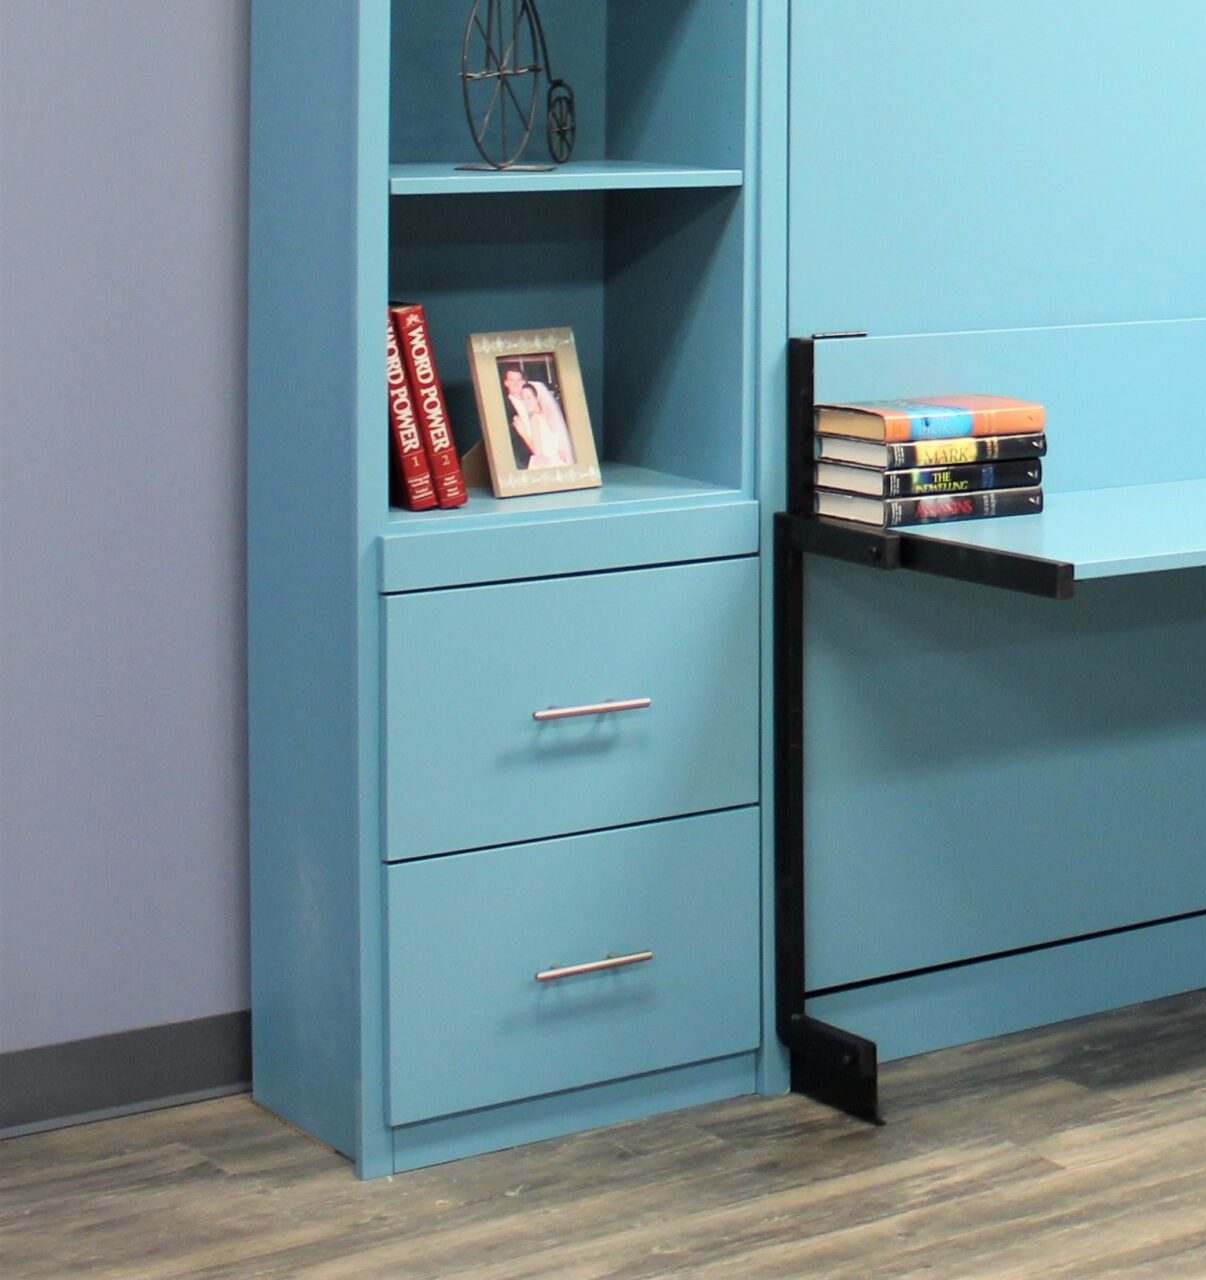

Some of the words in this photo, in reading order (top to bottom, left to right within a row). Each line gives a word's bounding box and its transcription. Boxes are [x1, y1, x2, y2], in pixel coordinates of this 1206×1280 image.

[407, 325, 435, 384] WORD
[390, 385, 420, 454] POWER
[412, 456, 420, 468] 1
[420, 385, 451, 453] POWER
[441, 455, 451, 466] 2
[924, 447, 968, 465] MARK
[932, 471, 951, 483] THE
